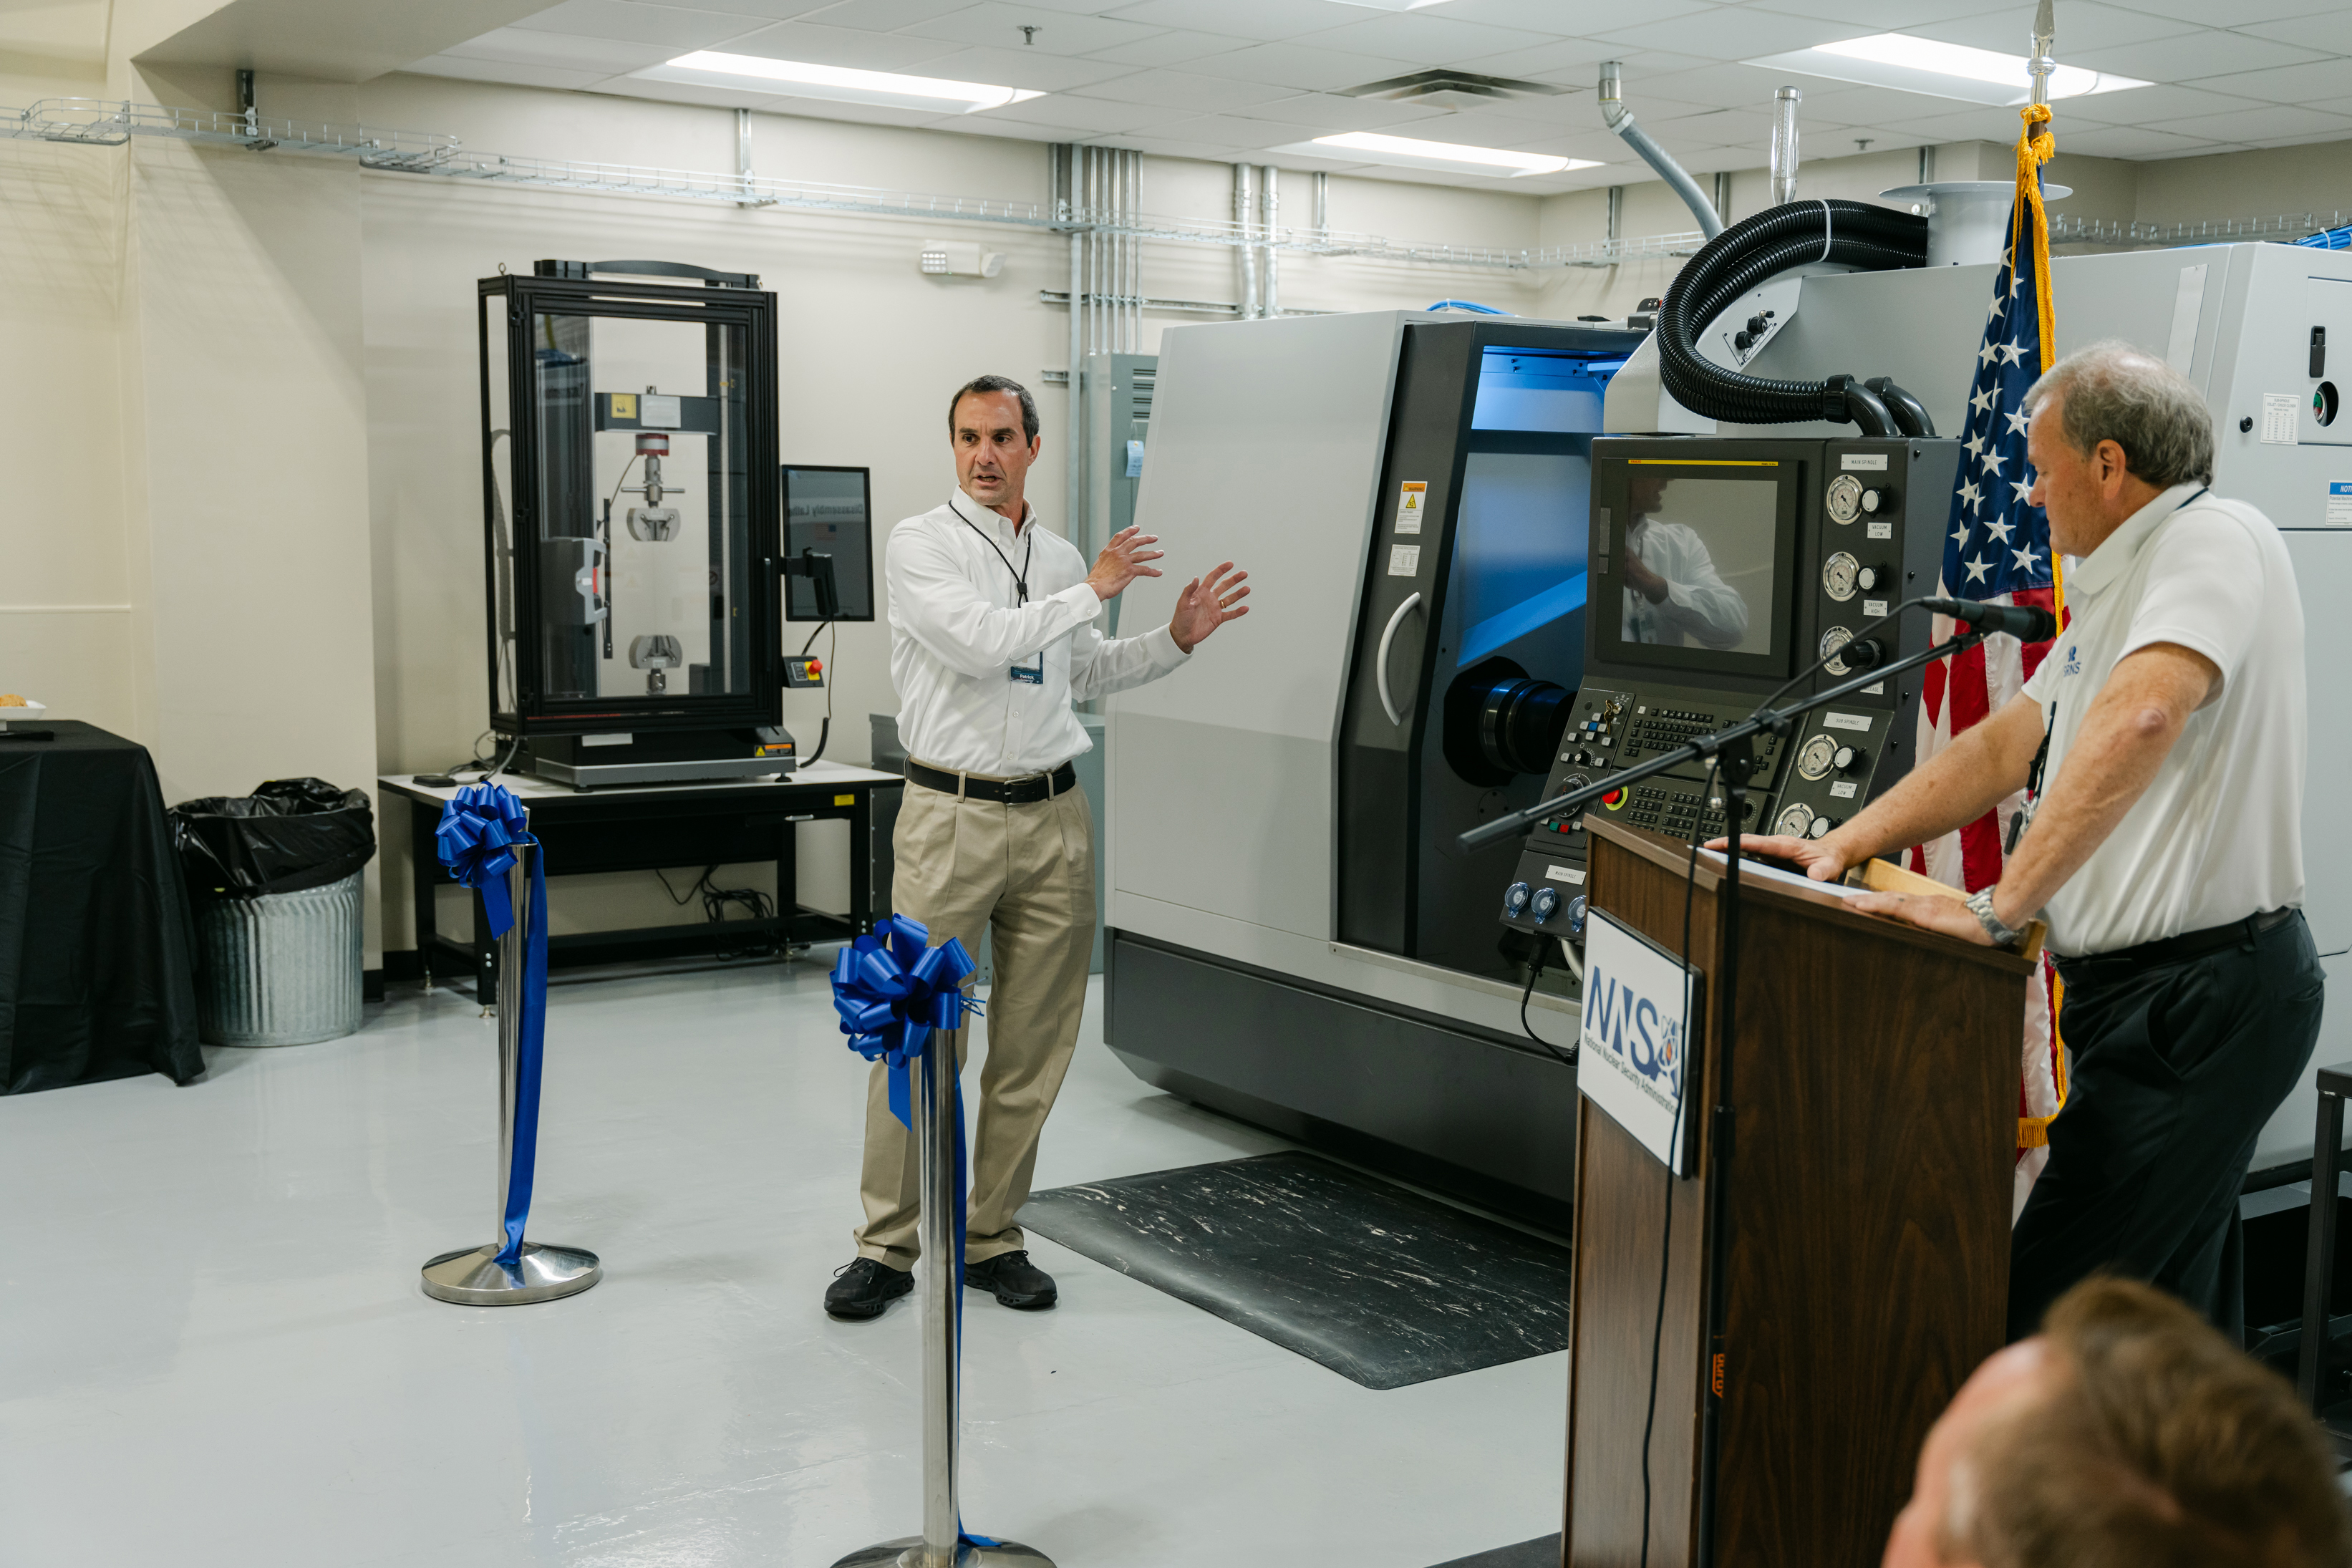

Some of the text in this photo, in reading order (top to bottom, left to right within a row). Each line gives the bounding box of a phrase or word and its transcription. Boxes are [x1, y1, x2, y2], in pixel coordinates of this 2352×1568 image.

[1584, 1031, 1602, 1057] National
[1602, 1046, 1620, 1070] Nuclear
[1620, 1060, 1640, 1090] Security
